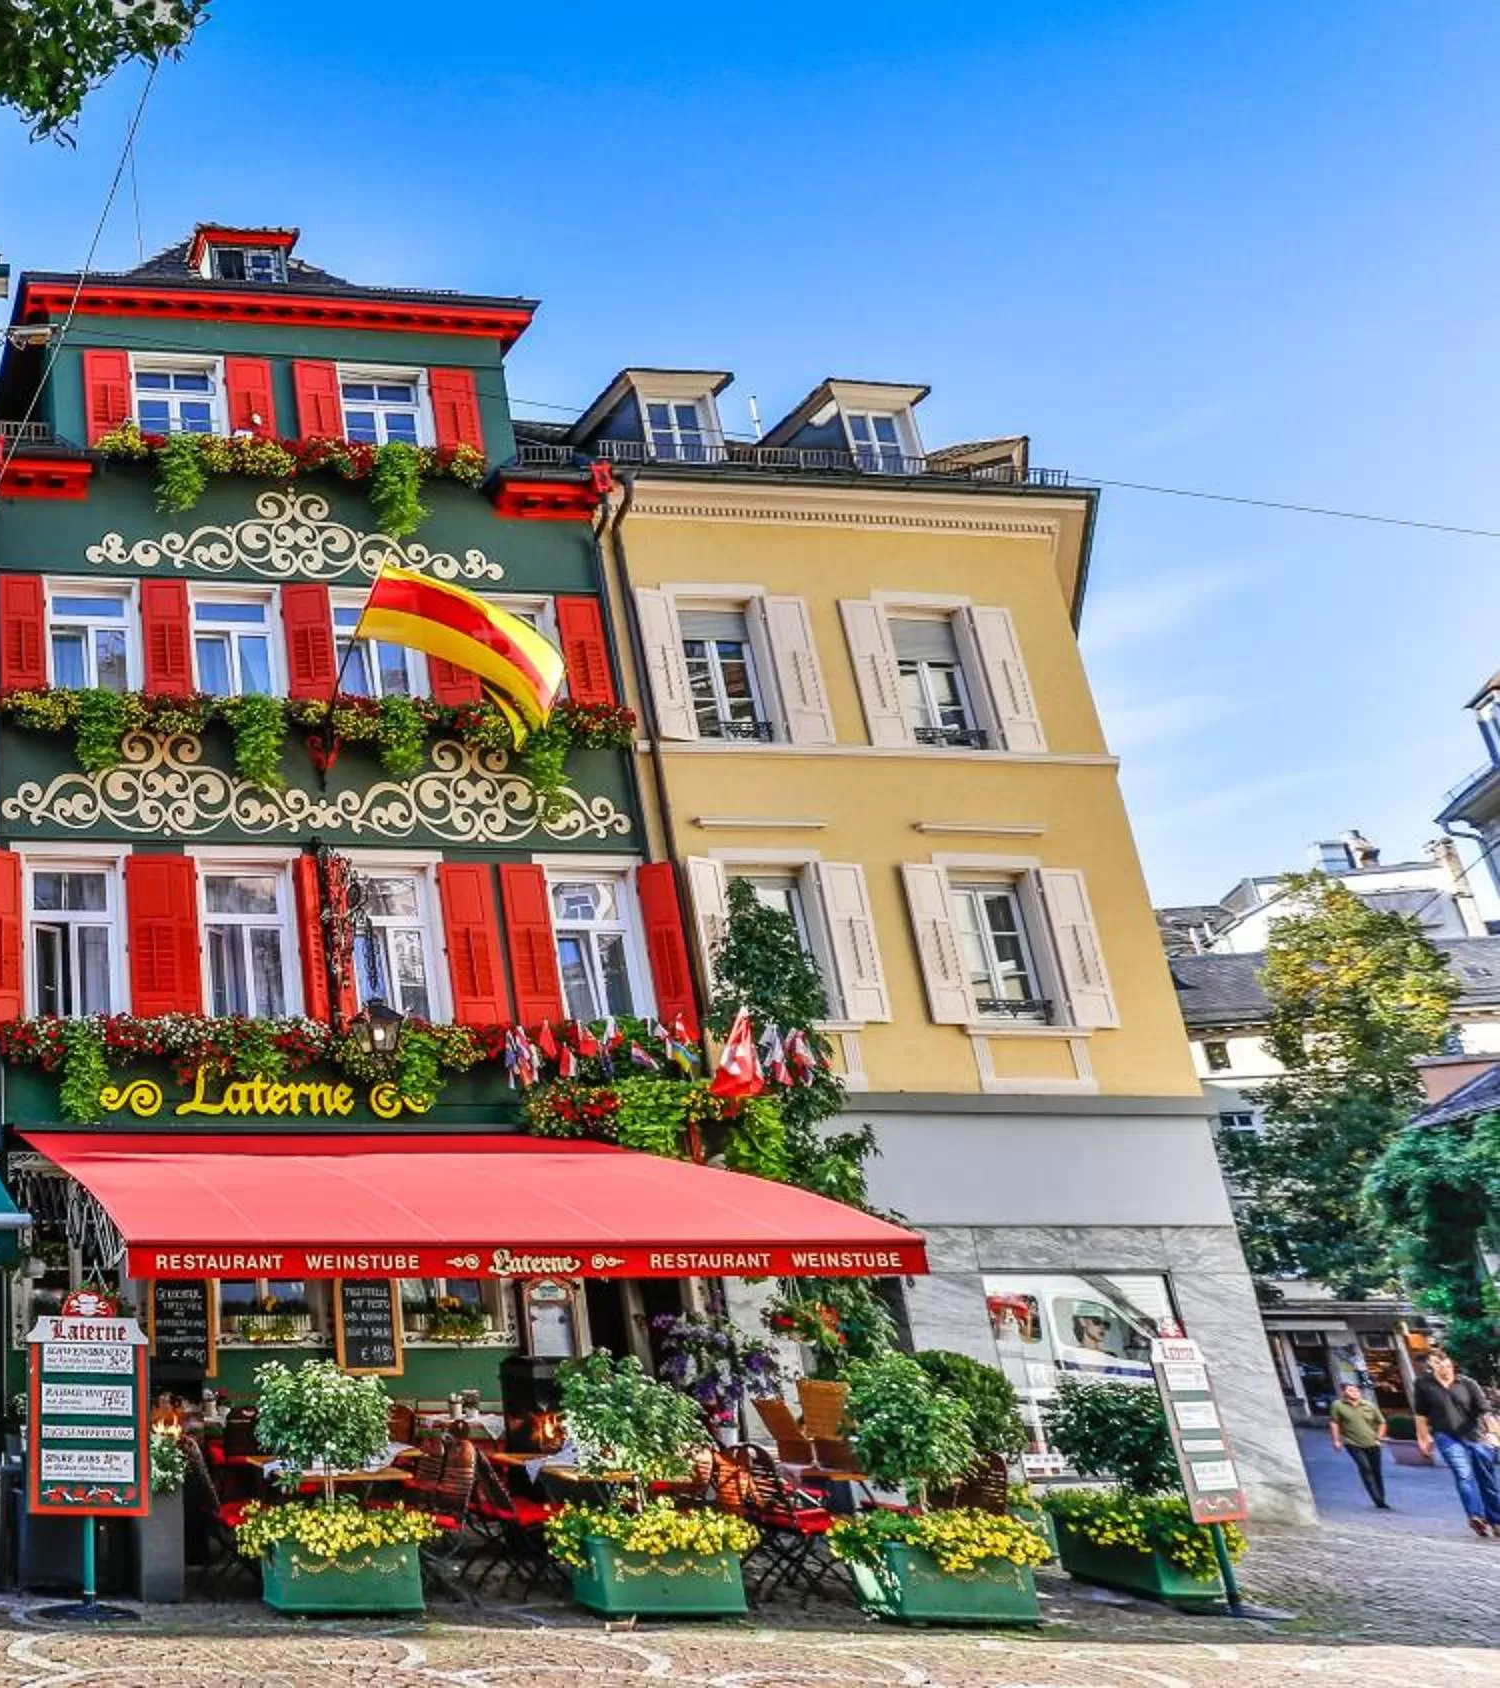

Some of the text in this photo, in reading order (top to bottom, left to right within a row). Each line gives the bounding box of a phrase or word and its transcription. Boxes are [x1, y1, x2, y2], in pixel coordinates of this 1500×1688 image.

[175, 1066, 354, 1117] Laterne
[155, 1247, 903, 1276] RESTAURANT WEINSTUBE Laterne RESTAURANT WEINSTUBE
[49, 1318, 128, 1341] Laterne
